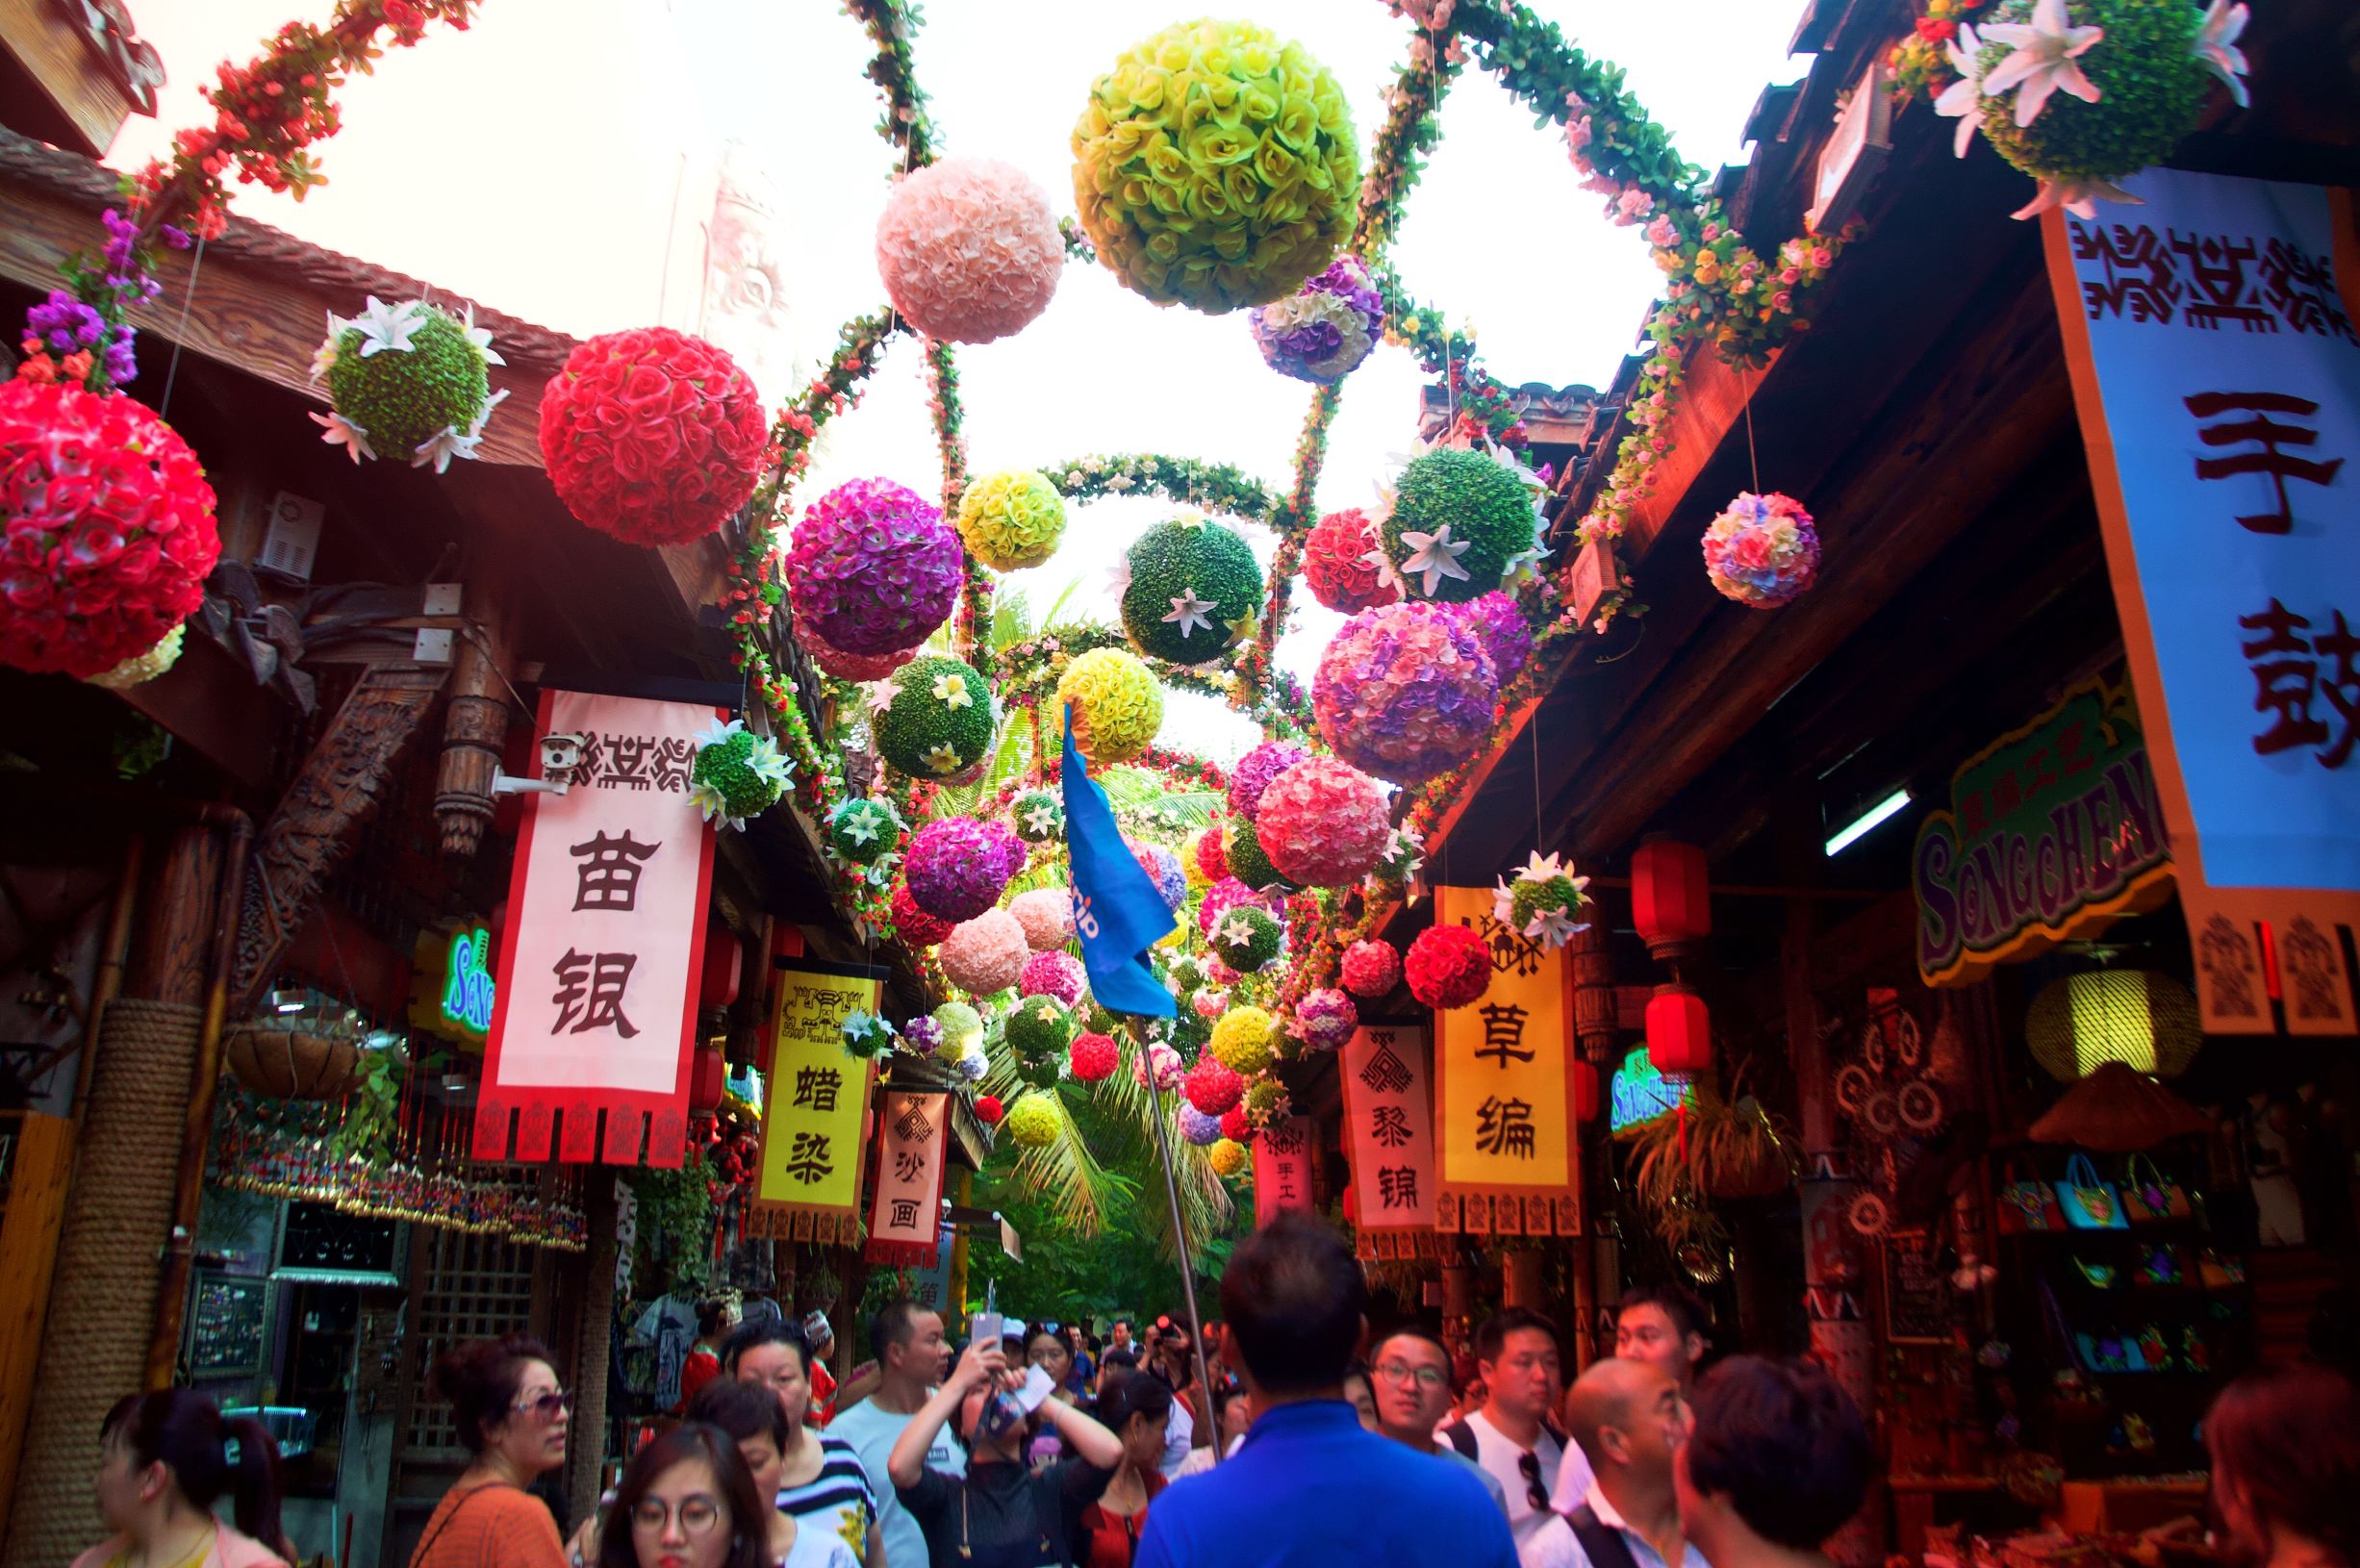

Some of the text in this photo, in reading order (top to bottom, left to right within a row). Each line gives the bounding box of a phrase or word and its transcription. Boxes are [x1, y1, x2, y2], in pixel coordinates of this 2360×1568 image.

[2182, 392, 2360, 770] 手鼓
[551, 829, 662, 1039] 苗银
[1918, 750, 2170, 965] SONGCHEN
[786, 1065, 842, 1186] 蜡染
[1372, 1106, 1417, 1209] 黎锦
[1474, 1002, 1535, 1160] 草编
[890, 1151, 925, 1229] 沙画
